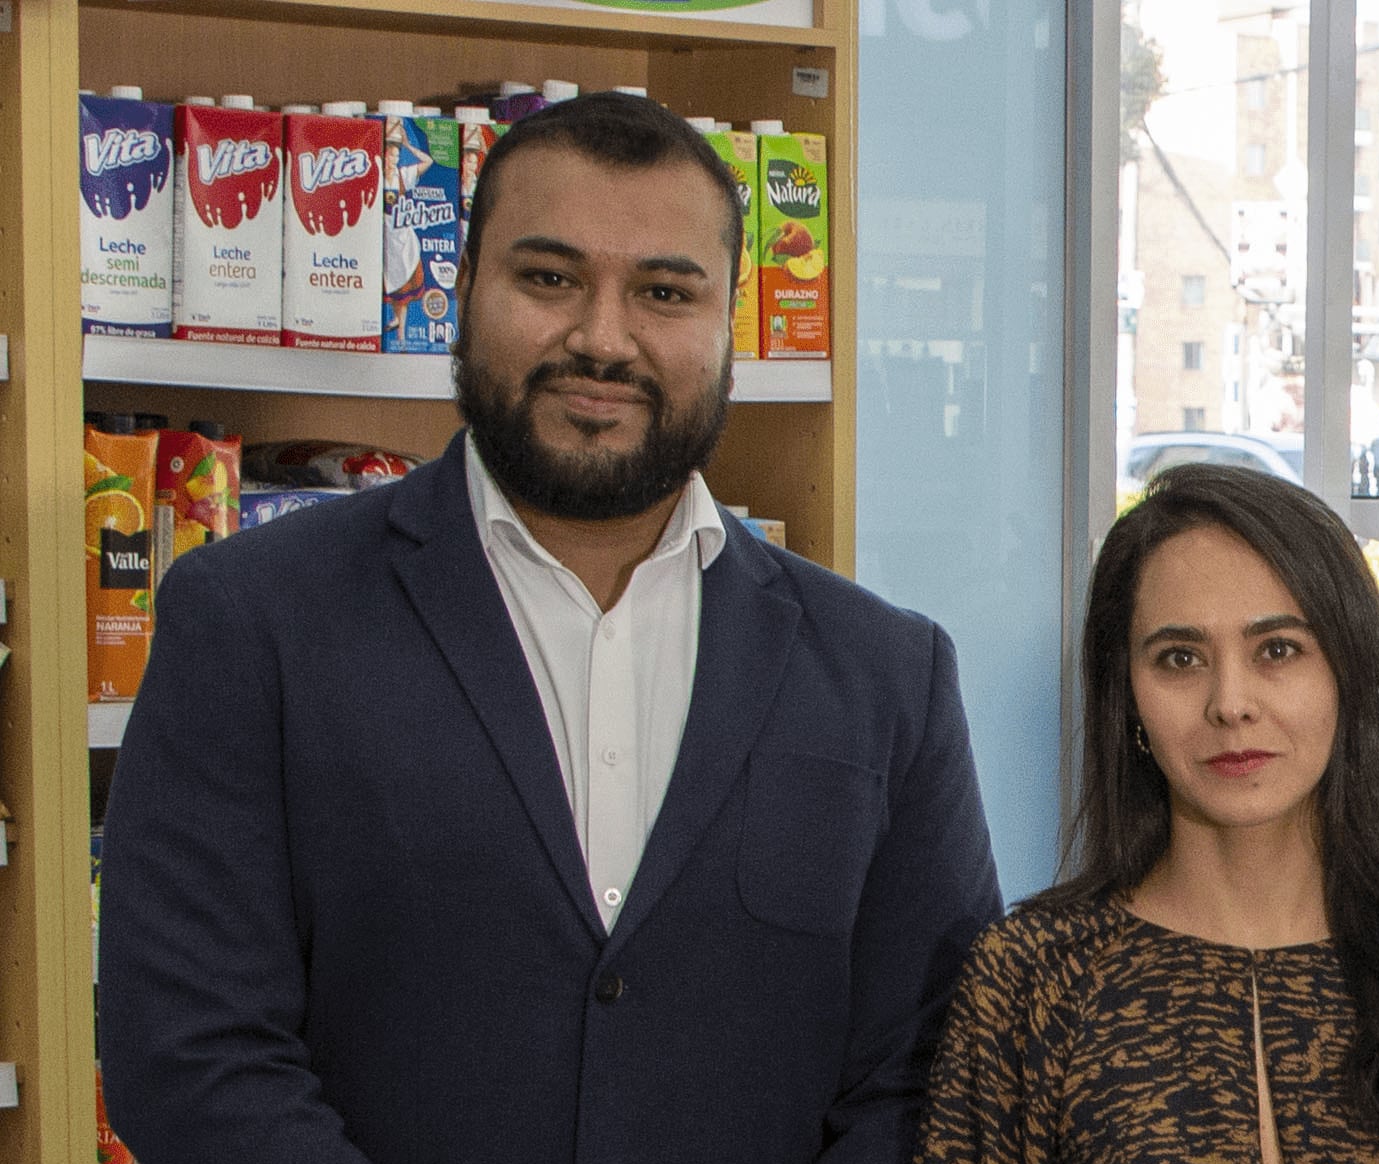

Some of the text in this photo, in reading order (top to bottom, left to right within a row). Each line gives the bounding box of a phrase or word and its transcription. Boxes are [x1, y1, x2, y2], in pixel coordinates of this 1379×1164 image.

[84, 128, 161, 176] Vita
[197, 138, 272, 184] Vita
[299, 147, 370, 193] Vita
[766, 178, 821, 208] Natura
[392, 204, 456, 229] Lechera
[99, 236, 146, 255] Leche
[213, 246, 251, 261] Leche
[422, 238, 456, 253] ENTERA
[107, 257, 140, 270] semi
[313, 252, 358, 269] Leche
[81, 268, 167, 290] descremada
[209, 262, 256, 280] entera
[310, 272, 363, 288] entera
[775, 290, 819, 299] DURAZNO
[187, 327, 280, 345] Fuente natural de calcio
[295, 339, 376, 352] Fuente natural de calcio
[106, 552, 149, 571] Valle
[96, 621, 142, 633] NARANJA
